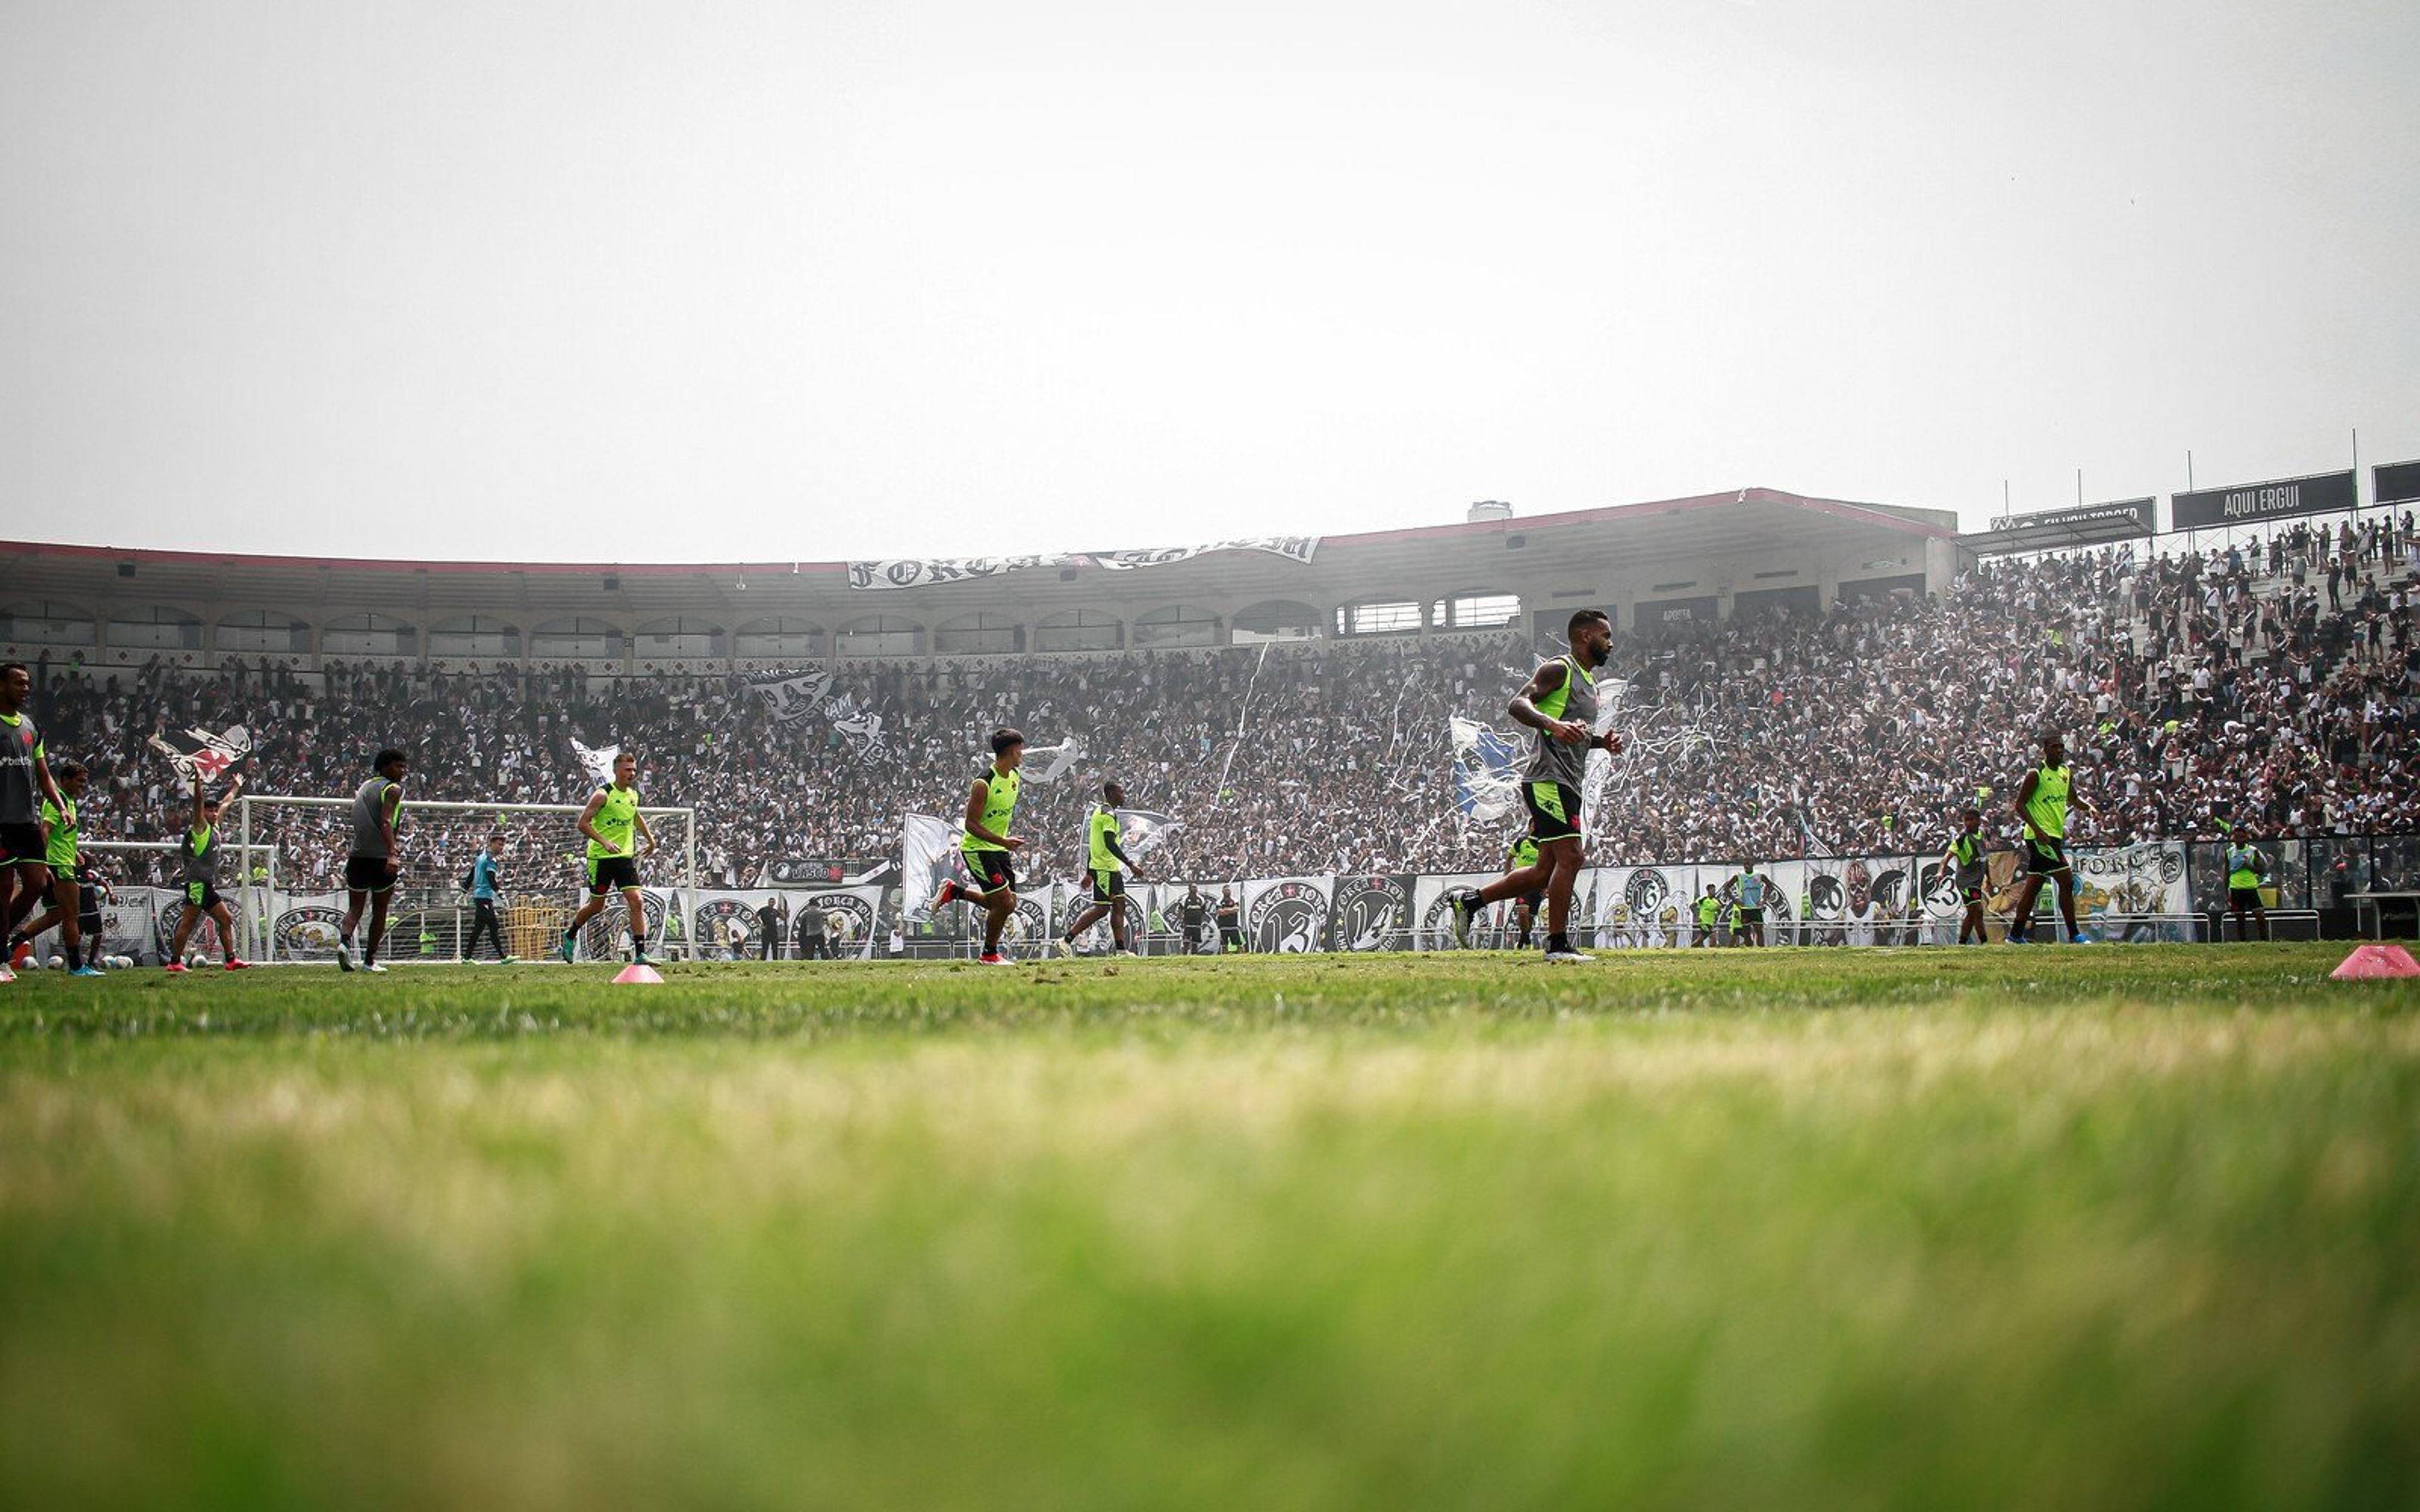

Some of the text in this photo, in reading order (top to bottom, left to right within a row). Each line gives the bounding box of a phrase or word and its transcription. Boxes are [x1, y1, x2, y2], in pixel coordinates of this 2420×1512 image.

[2224, 485, 2300, 518] AQUI ERGUI
[1632, 881, 1657, 910] 16
[1813, 883, 1843, 912] 20
[1925, 874, 1959, 907] 23
[1267, 911, 1311, 953] 13
[1352, 900, 1392, 947] 14
